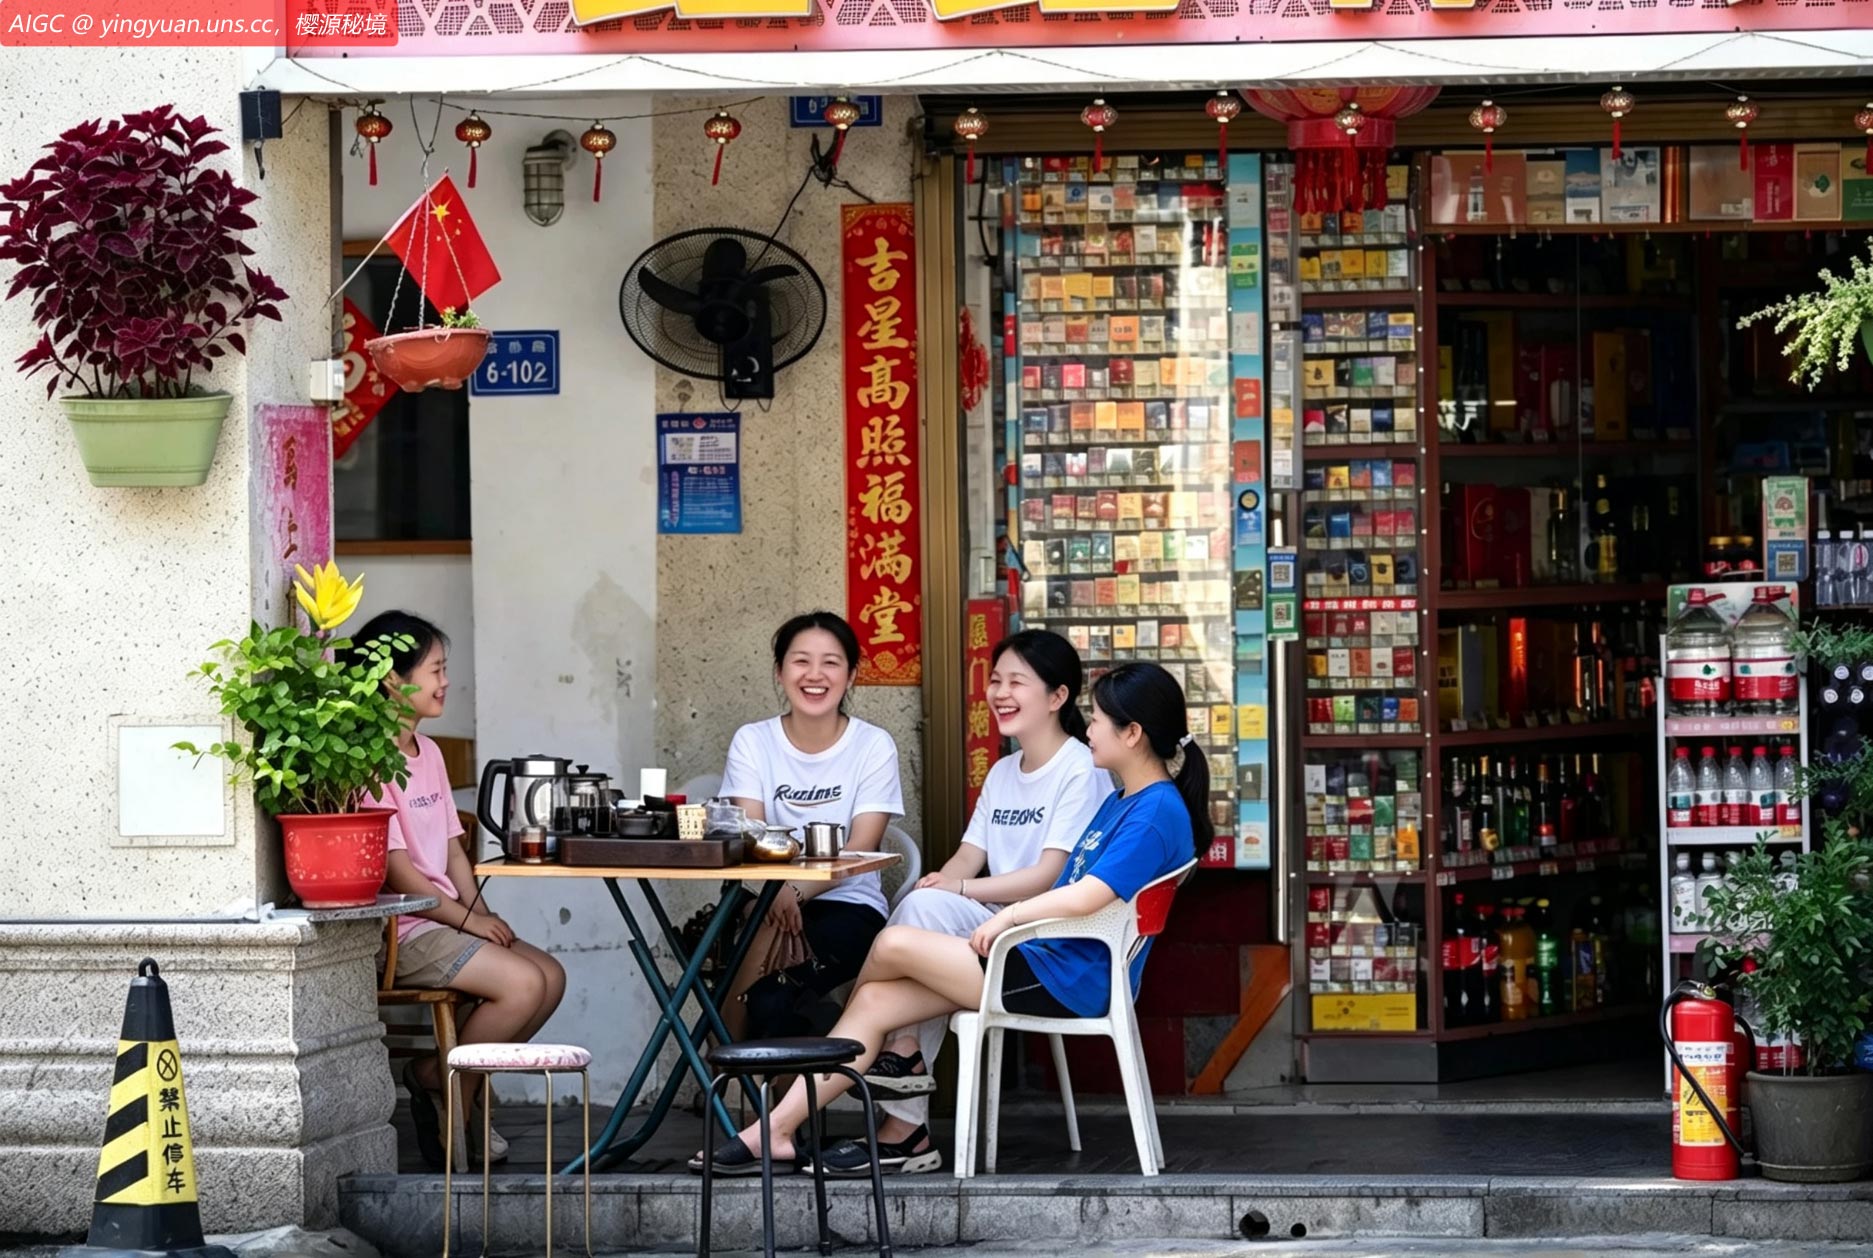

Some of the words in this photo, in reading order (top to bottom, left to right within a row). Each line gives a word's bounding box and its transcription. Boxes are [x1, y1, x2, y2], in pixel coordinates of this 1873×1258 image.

[487, 359, 548, 384] 6-102
[855, 237, 914, 645] 吉星高照福满堂
